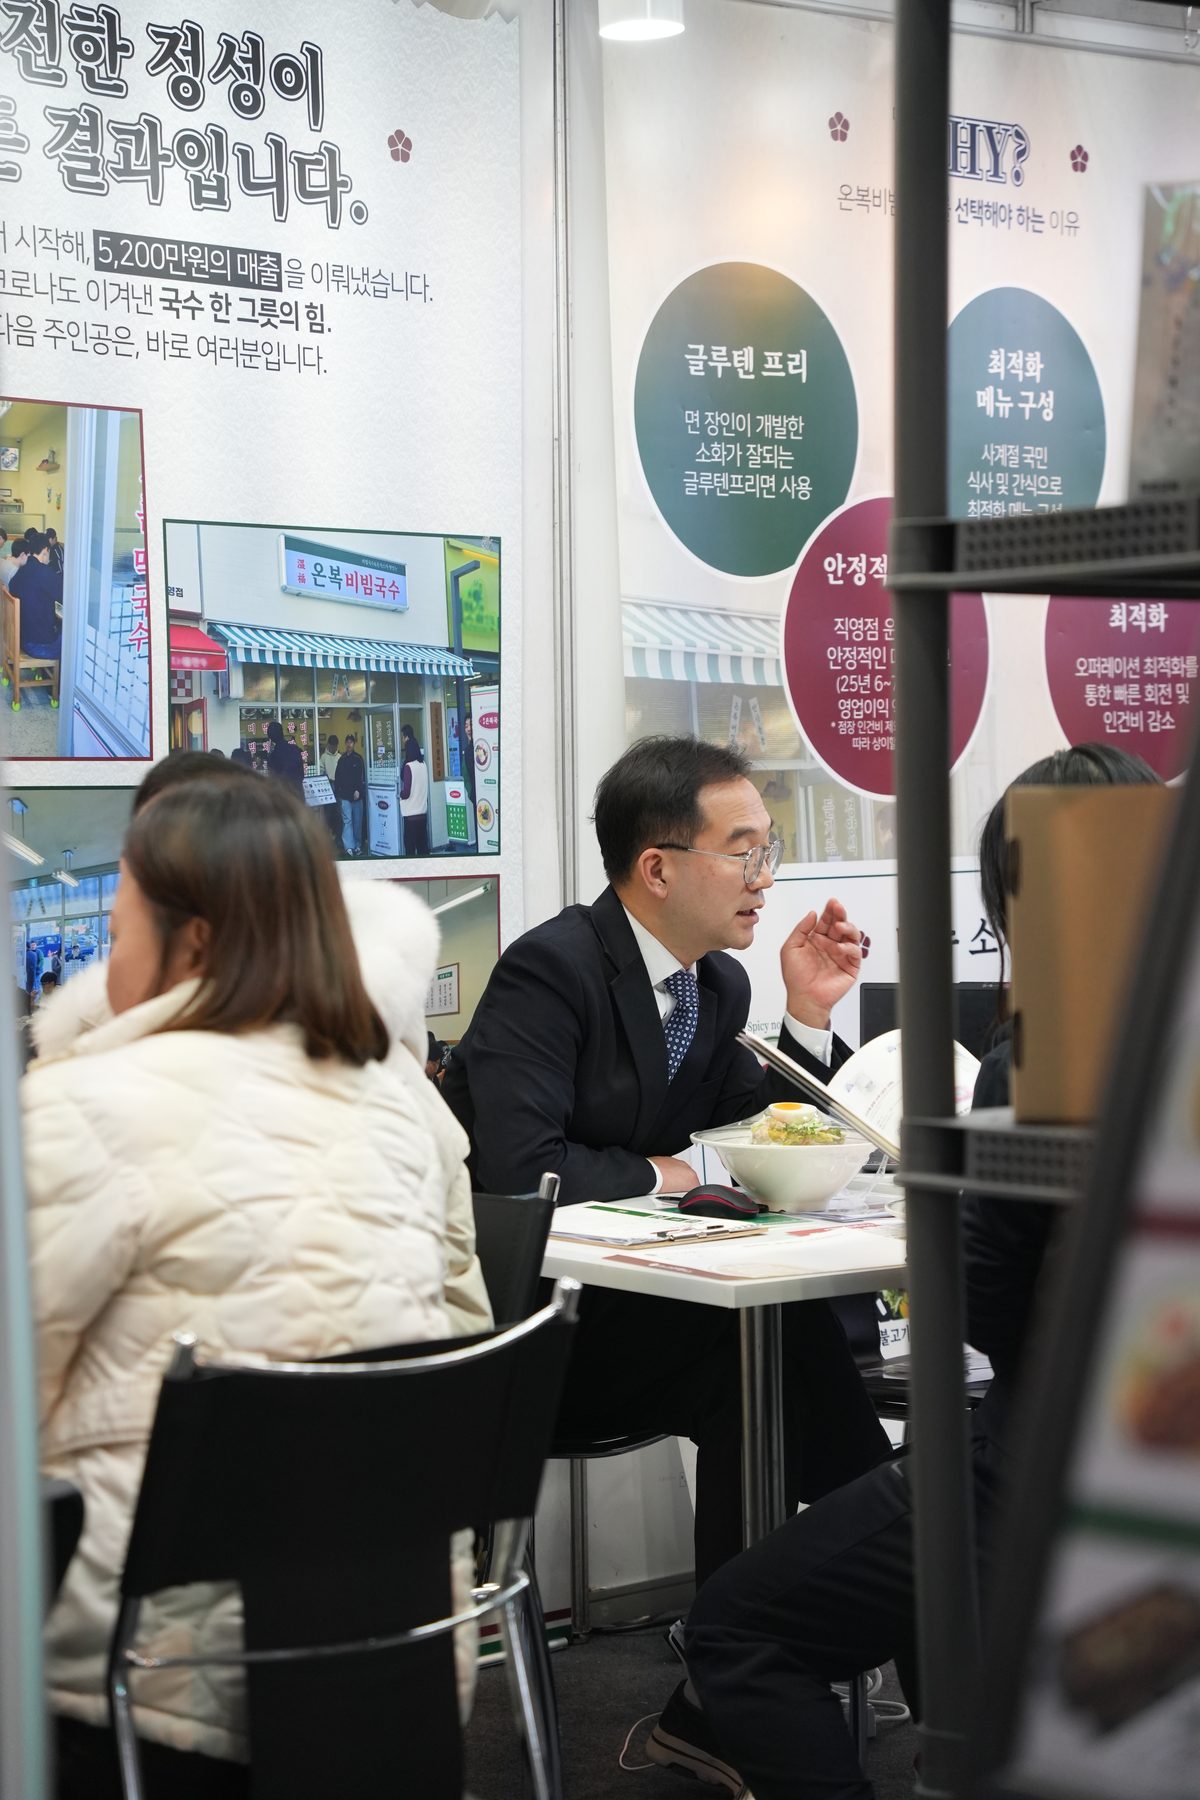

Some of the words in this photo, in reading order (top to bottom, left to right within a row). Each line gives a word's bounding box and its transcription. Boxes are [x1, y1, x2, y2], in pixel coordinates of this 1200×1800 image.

[146, 19, 322, 132] 정성이
[947, 115, 1031, 187] HY?
[43, 102, 368, 230] 결과입니다.
[955, 197, 1013, 229] 선택해야
[1016, 205, 1044, 234] 하는
[1049, 209, 1081, 237] 이유
[15, 225, 90, 265] 시작해,
[98, 236, 232, 282] 5,200만원의
[310, 261, 433, 303] 이뤄냈습니다.
[86, 278, 154, 316] 이겨낸
[159, 287, 205, 321] 국수
[209, 291, 233, 324] 한
[236, 297, 300, 331] 그릇의
[304, 302, 332, 334] 힘.
[43, 318, 140, 360] 주인공은,
[146, 330, 192, 360] 바로
[197, 334, 328, 375] 여러분입니다.
[684, 344, 755, 379] 글루텐
[761, 349, 807, 383] 프리
[987, 348, 1044, 383] 최적화
[976, 386, 1014, 418] 메뉴
[1017, 390, 1054, 421] 구성
[685, 410, 700, 435] 면
[704, 411, 751, 437] 장인이
[756, 414, 805, 440] 개발한
[695, 442, 742, 468] 소화가
[746, 444, 794, 469] 잘되는
[981, 443, 1019, 468] 사계절
[1022, 446, 1048, 469] 국민
[683, 471, 776, 498] 글루텐프리면
[780, 475, 812, 500] 사용
[967, 471, 993, 494] 식사
[996, 472, 1009, 496] 및
[1011, 474, 1063, 497] 간식으로
[967, 500, 1007, 520] 최적화
[834, 617, 878, 641] 직영점
[1109, 602, 1168, 633] 최적화
[827, 646, 886, 670] 안정적인
[1075, 656, 1140, 679] 오퍼레이션
[1143, 655, 1199, 679] 최적화를
[836, 673, 870, 694] (25년
[1084, 684, 1112, 707] 통한
[1113, 684, 1142, 706] 빠른
[1144, 683, 1172, 706] 회전
[1175, 682, 1190, 705] 및
[838, 698, 889, 719] 영업이익
[1103, 710, 1144, 733] 인건비
[1147, 710, 1176, 733] 감소
[857, 720, 883, 734] 인건비
[852, 736, 870, 751] 따라
[747, 1020, 769, 1034] Spicy
[771, 1021, 782, 1031] no
[880, 1324, 910, 1347] 불고기
